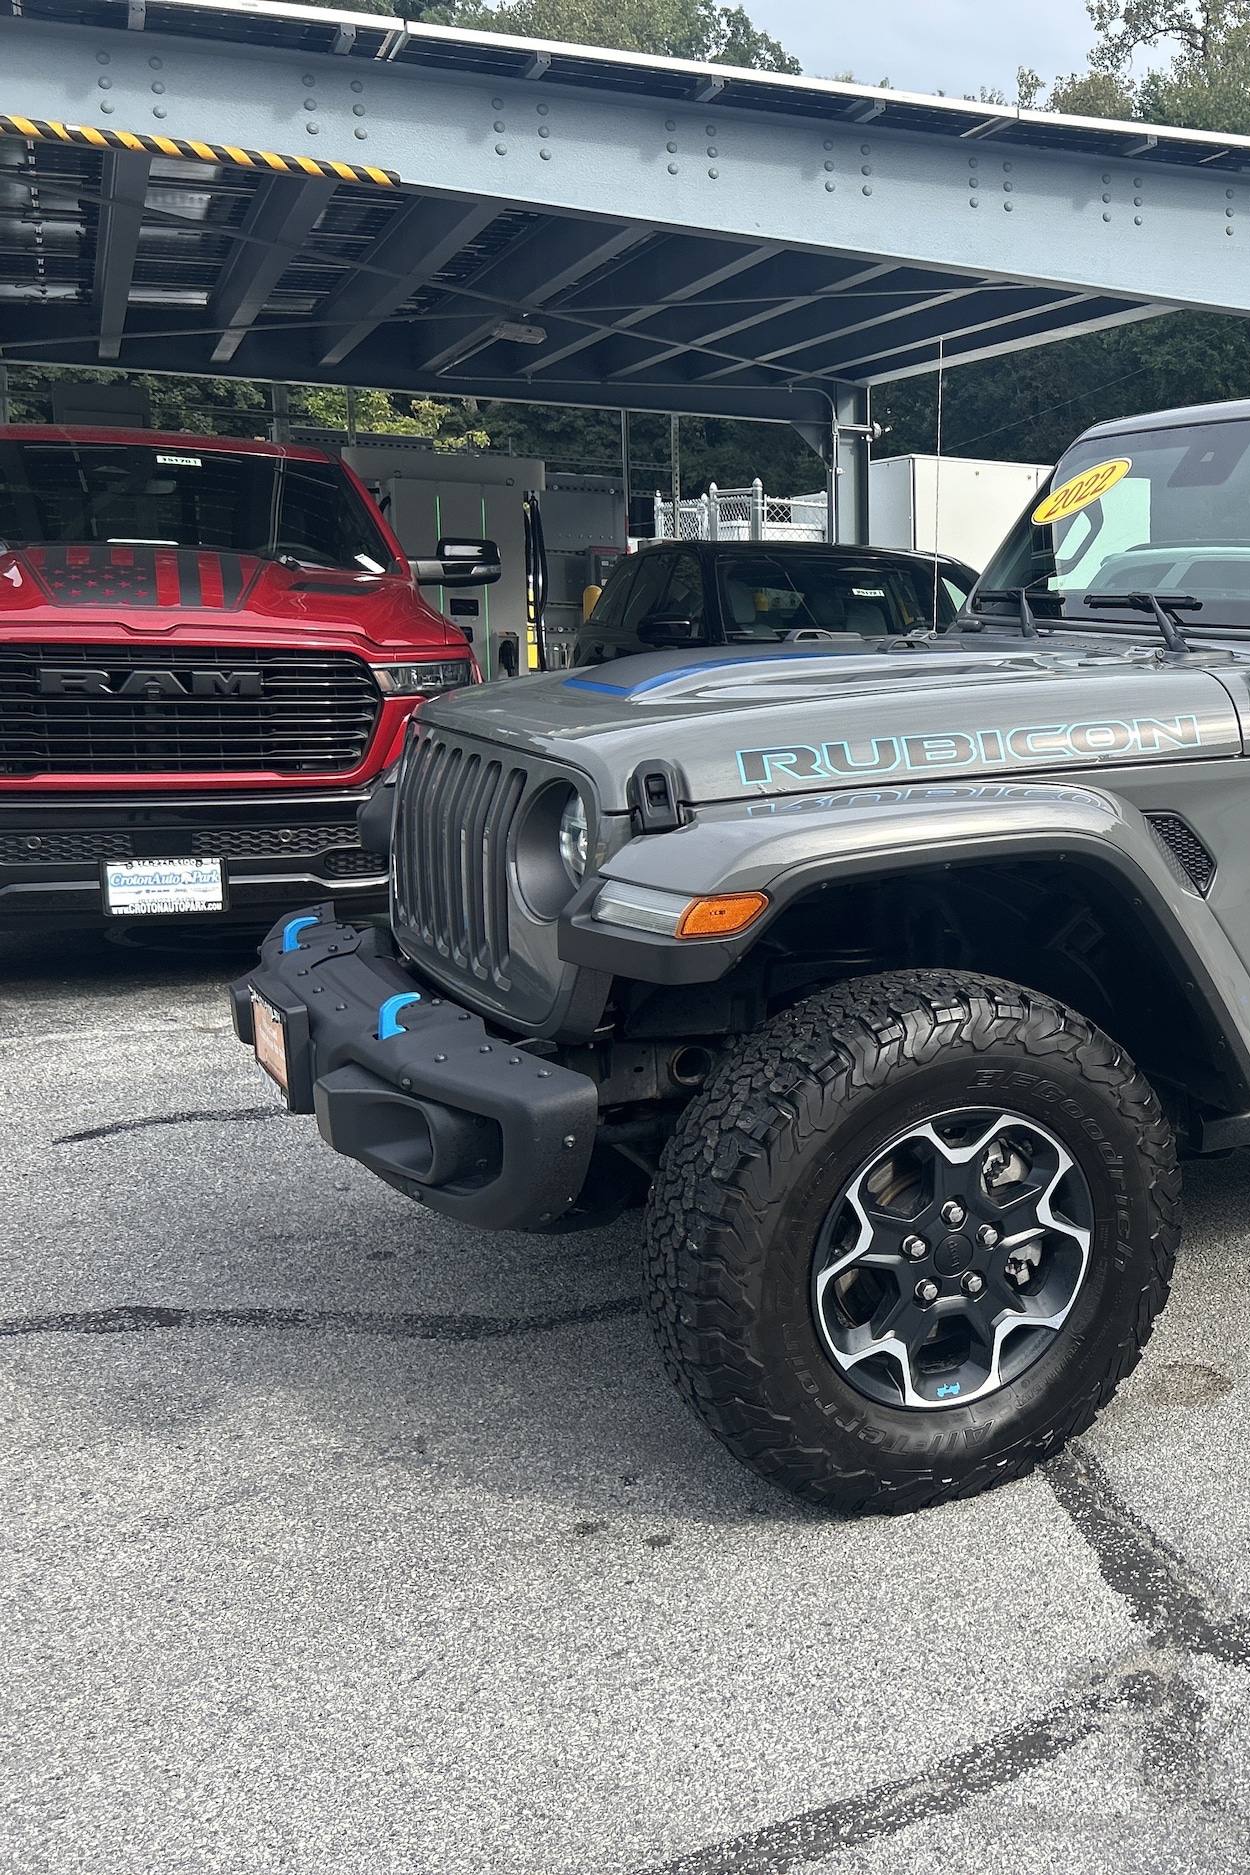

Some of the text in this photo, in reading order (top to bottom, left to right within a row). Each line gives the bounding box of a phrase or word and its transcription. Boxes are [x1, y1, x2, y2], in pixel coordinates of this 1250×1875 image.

[1043, 464, 1117, 519] 2022
[39, 668, 265, 696] RAM
[735, 714, 1202, 786] RUBICON
[192, 869, 220, 884] Park
[966, 1069, 1134, 1273] BFGoodrich
